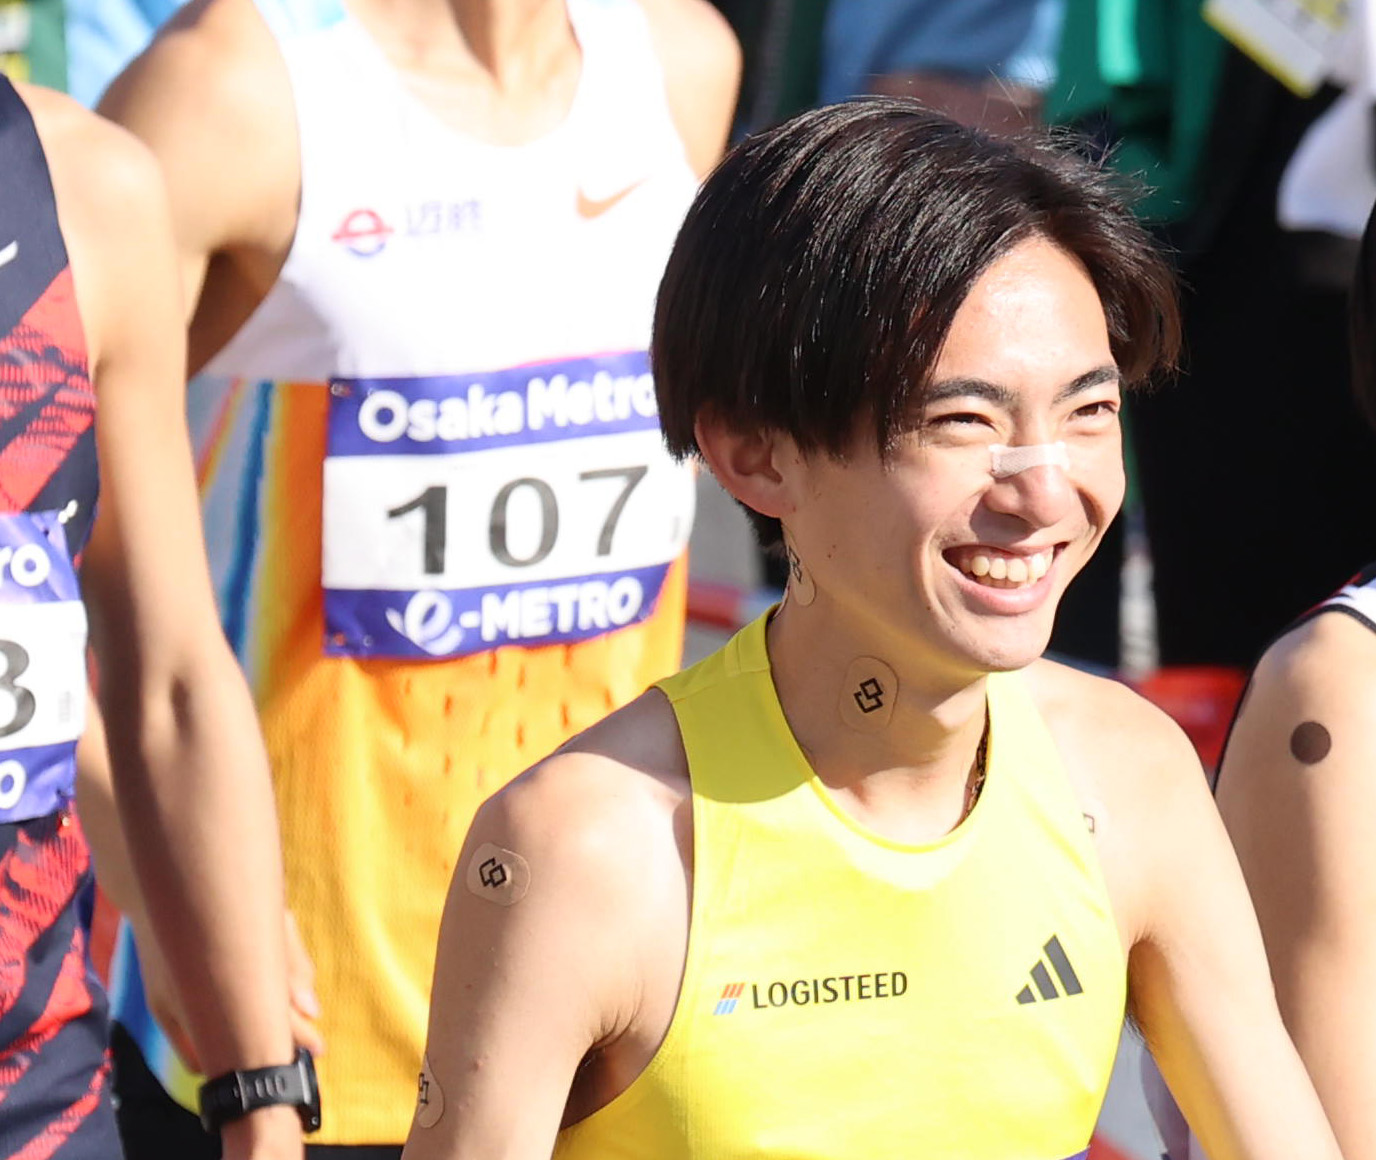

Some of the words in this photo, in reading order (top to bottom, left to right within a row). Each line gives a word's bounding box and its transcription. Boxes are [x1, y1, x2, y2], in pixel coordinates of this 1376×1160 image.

[358, 384, 524, 442] Osaka
[526, 371, 658, 430] Metro
[386, 465, 648, 574] 107
[752, 971, 908, 1009] LOGISTEED
